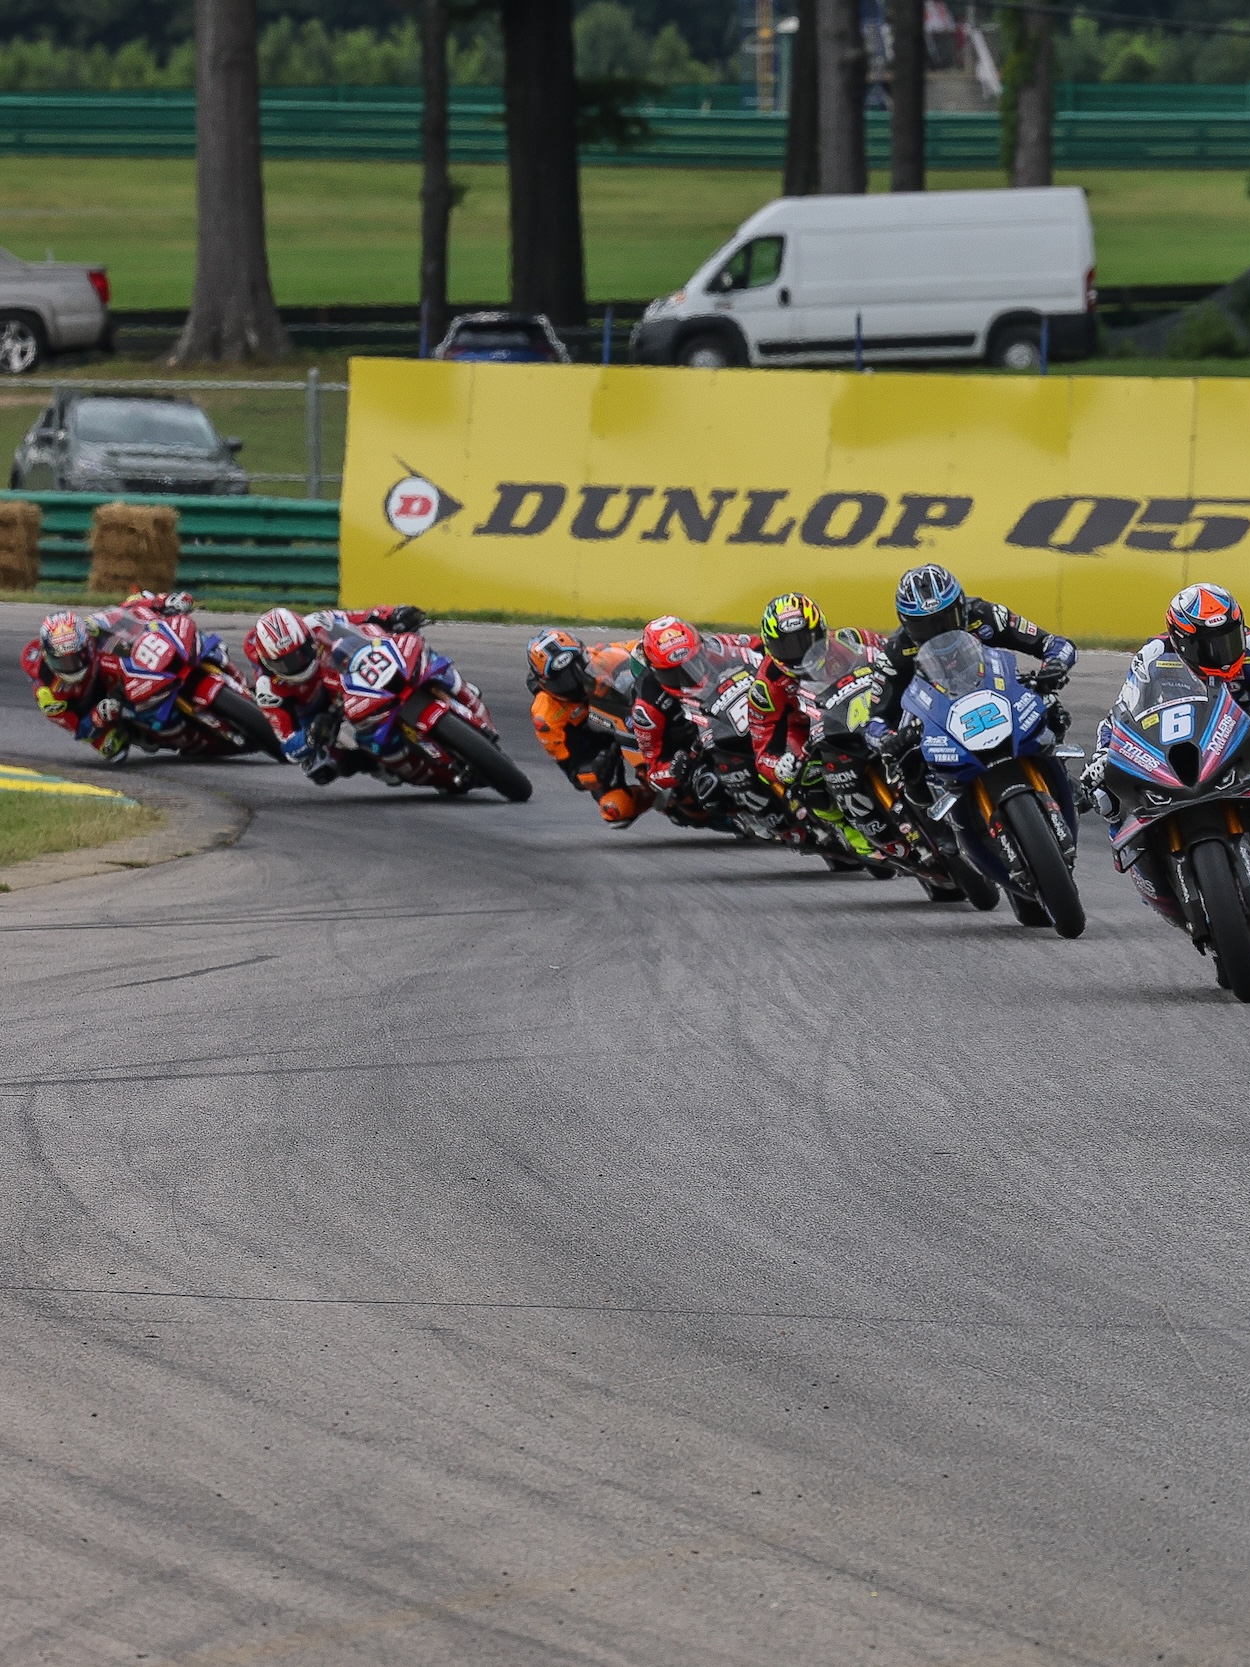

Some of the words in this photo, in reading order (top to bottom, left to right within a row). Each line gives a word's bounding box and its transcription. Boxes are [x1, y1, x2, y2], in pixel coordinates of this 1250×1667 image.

[471, 481, 974, 548] DUNLOP
[783, 618, 801, 630] Arai
[1208, 616, 1224, 625] BELL
[134, 633, 170, 671] 95
[358, 650, 393, 688] 69
[959, 702, 1009, 741] 32
[1160, 703, 1195, 745] 6
[1207, 713, 1234, 754] TYTLERS
[1123, 741, 1161, 769] TYTLERS
